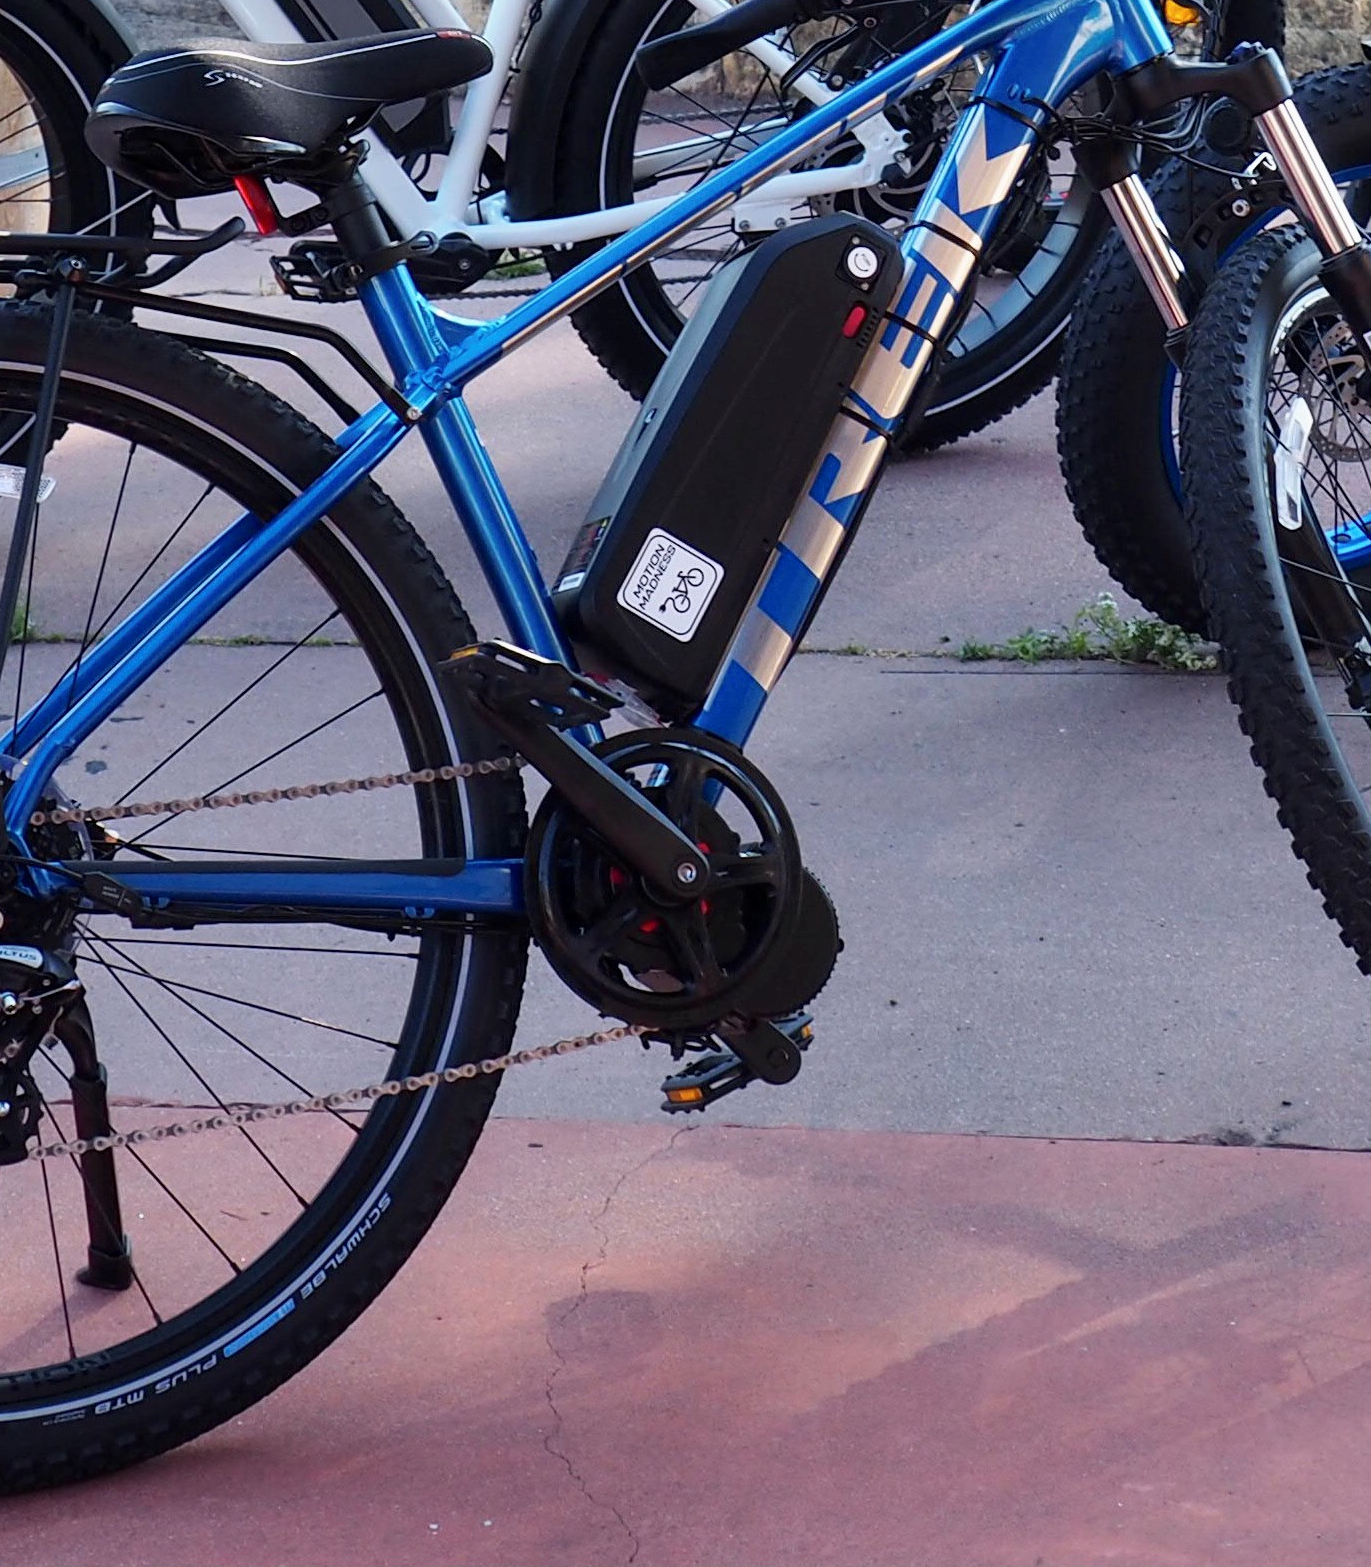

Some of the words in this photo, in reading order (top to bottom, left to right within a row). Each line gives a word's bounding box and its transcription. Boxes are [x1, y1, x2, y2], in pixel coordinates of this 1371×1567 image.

[703, 112, 1033, 710] TREK
[632, 543, 666, 599] MOTION
[638, 544, 677, 611] MADNESS
[300, 1191, 392, 1300] SCHWALBE
[94, 1388, 145, 1415] MTB
[154, 1353, 218, 1395] PLUS
